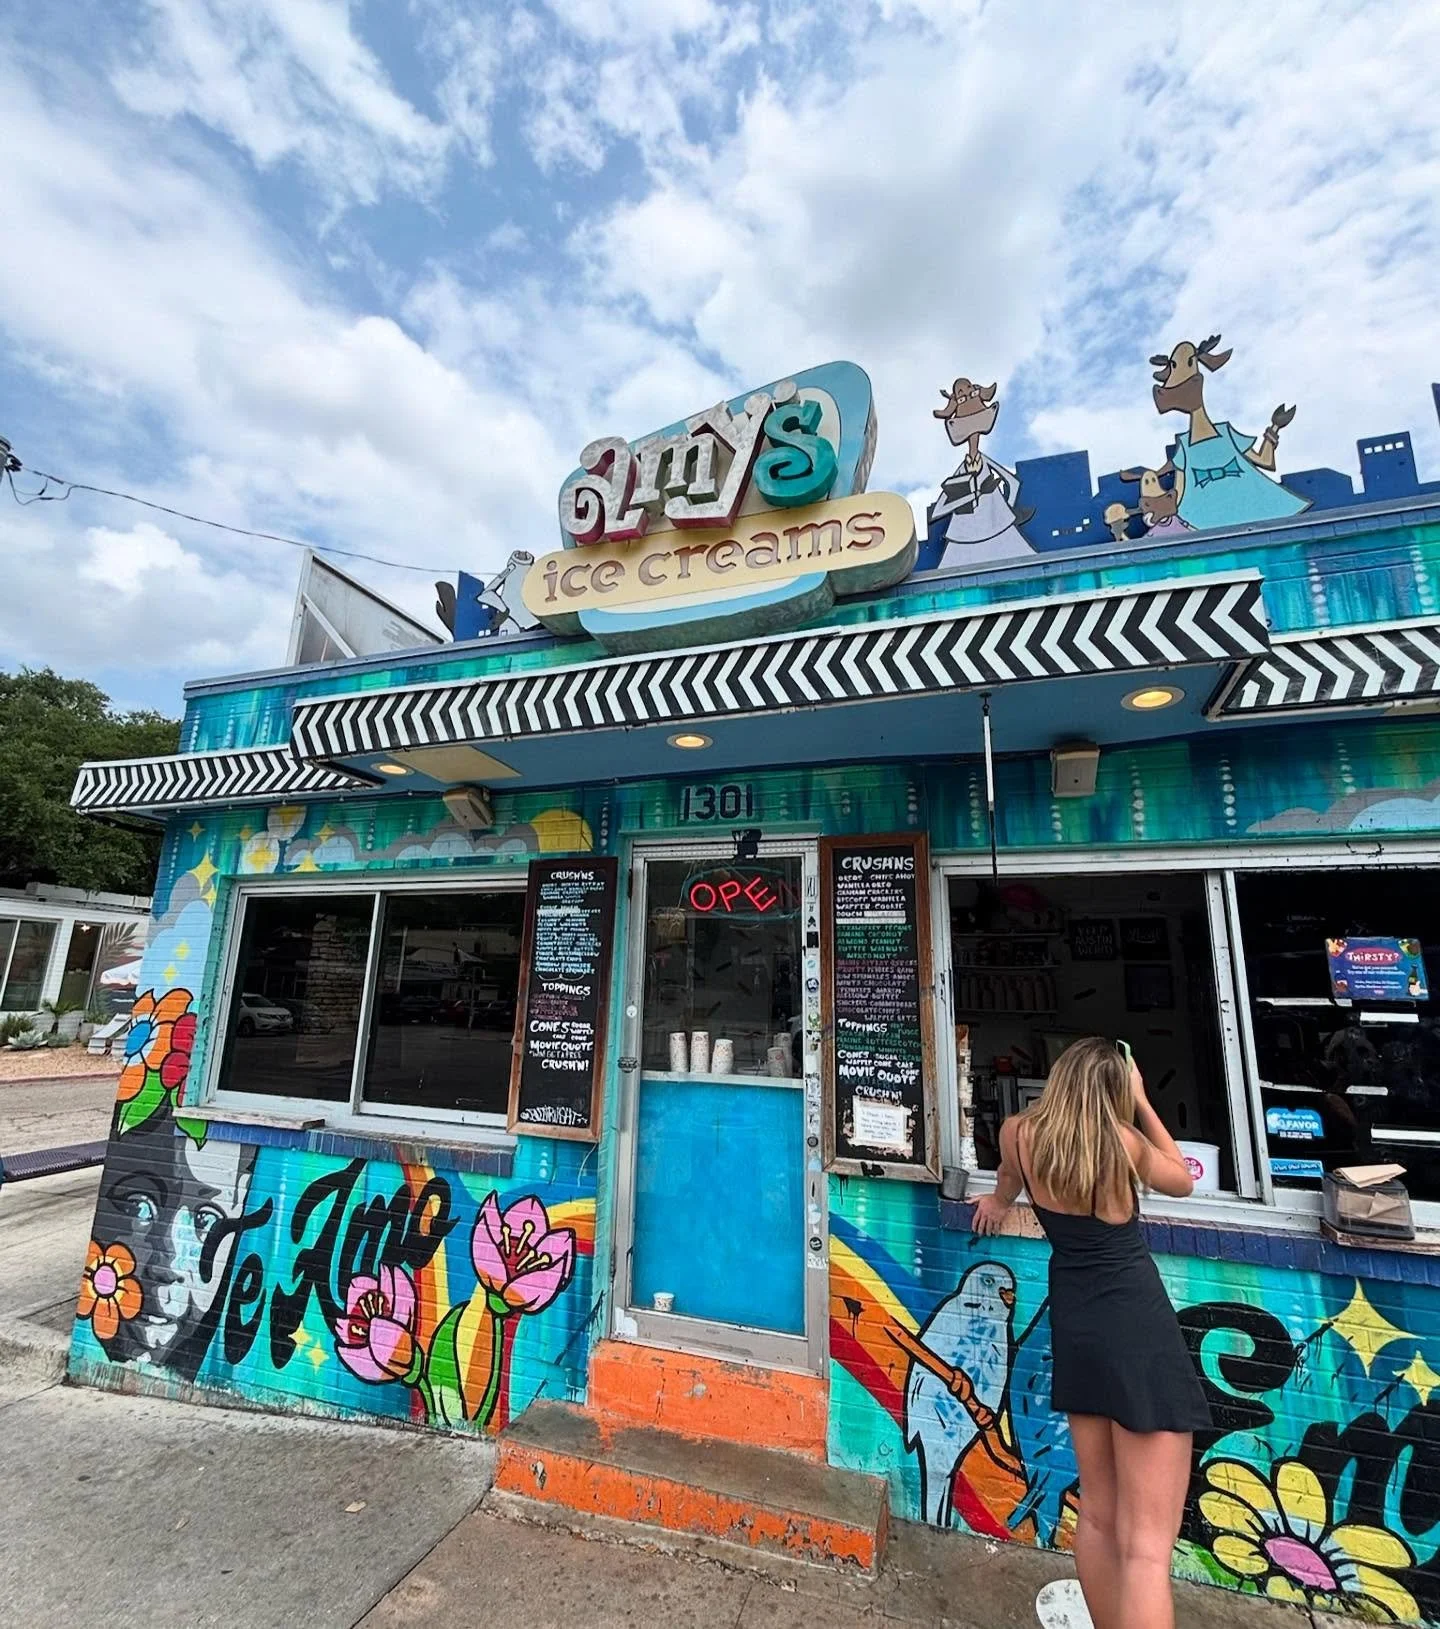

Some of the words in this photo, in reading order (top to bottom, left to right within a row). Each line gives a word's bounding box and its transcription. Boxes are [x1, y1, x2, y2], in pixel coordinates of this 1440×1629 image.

[543, 558, 626, 603] ice
[638, 510, 886, 587] creams
[681, 783, 754, 820] 1301
[542, 982, 590, 996] TOPPINGS
[530, 1020, 570, 1034] CONES
[838, 1018, 888, 1032] TOPPINGS
[530, 1040, 561, 1054] MOVIE
[561, 1042, 594, 1052] QUOTE
[838, 1050, 870, 1059] CONES
[838, 1064, 876, 1079] MOVIE
[1286, 1120, 1319, 1130] FAVOR
[190, 1196, 273, 1383] Te
[268, 1158, 461, 1370] Amo
